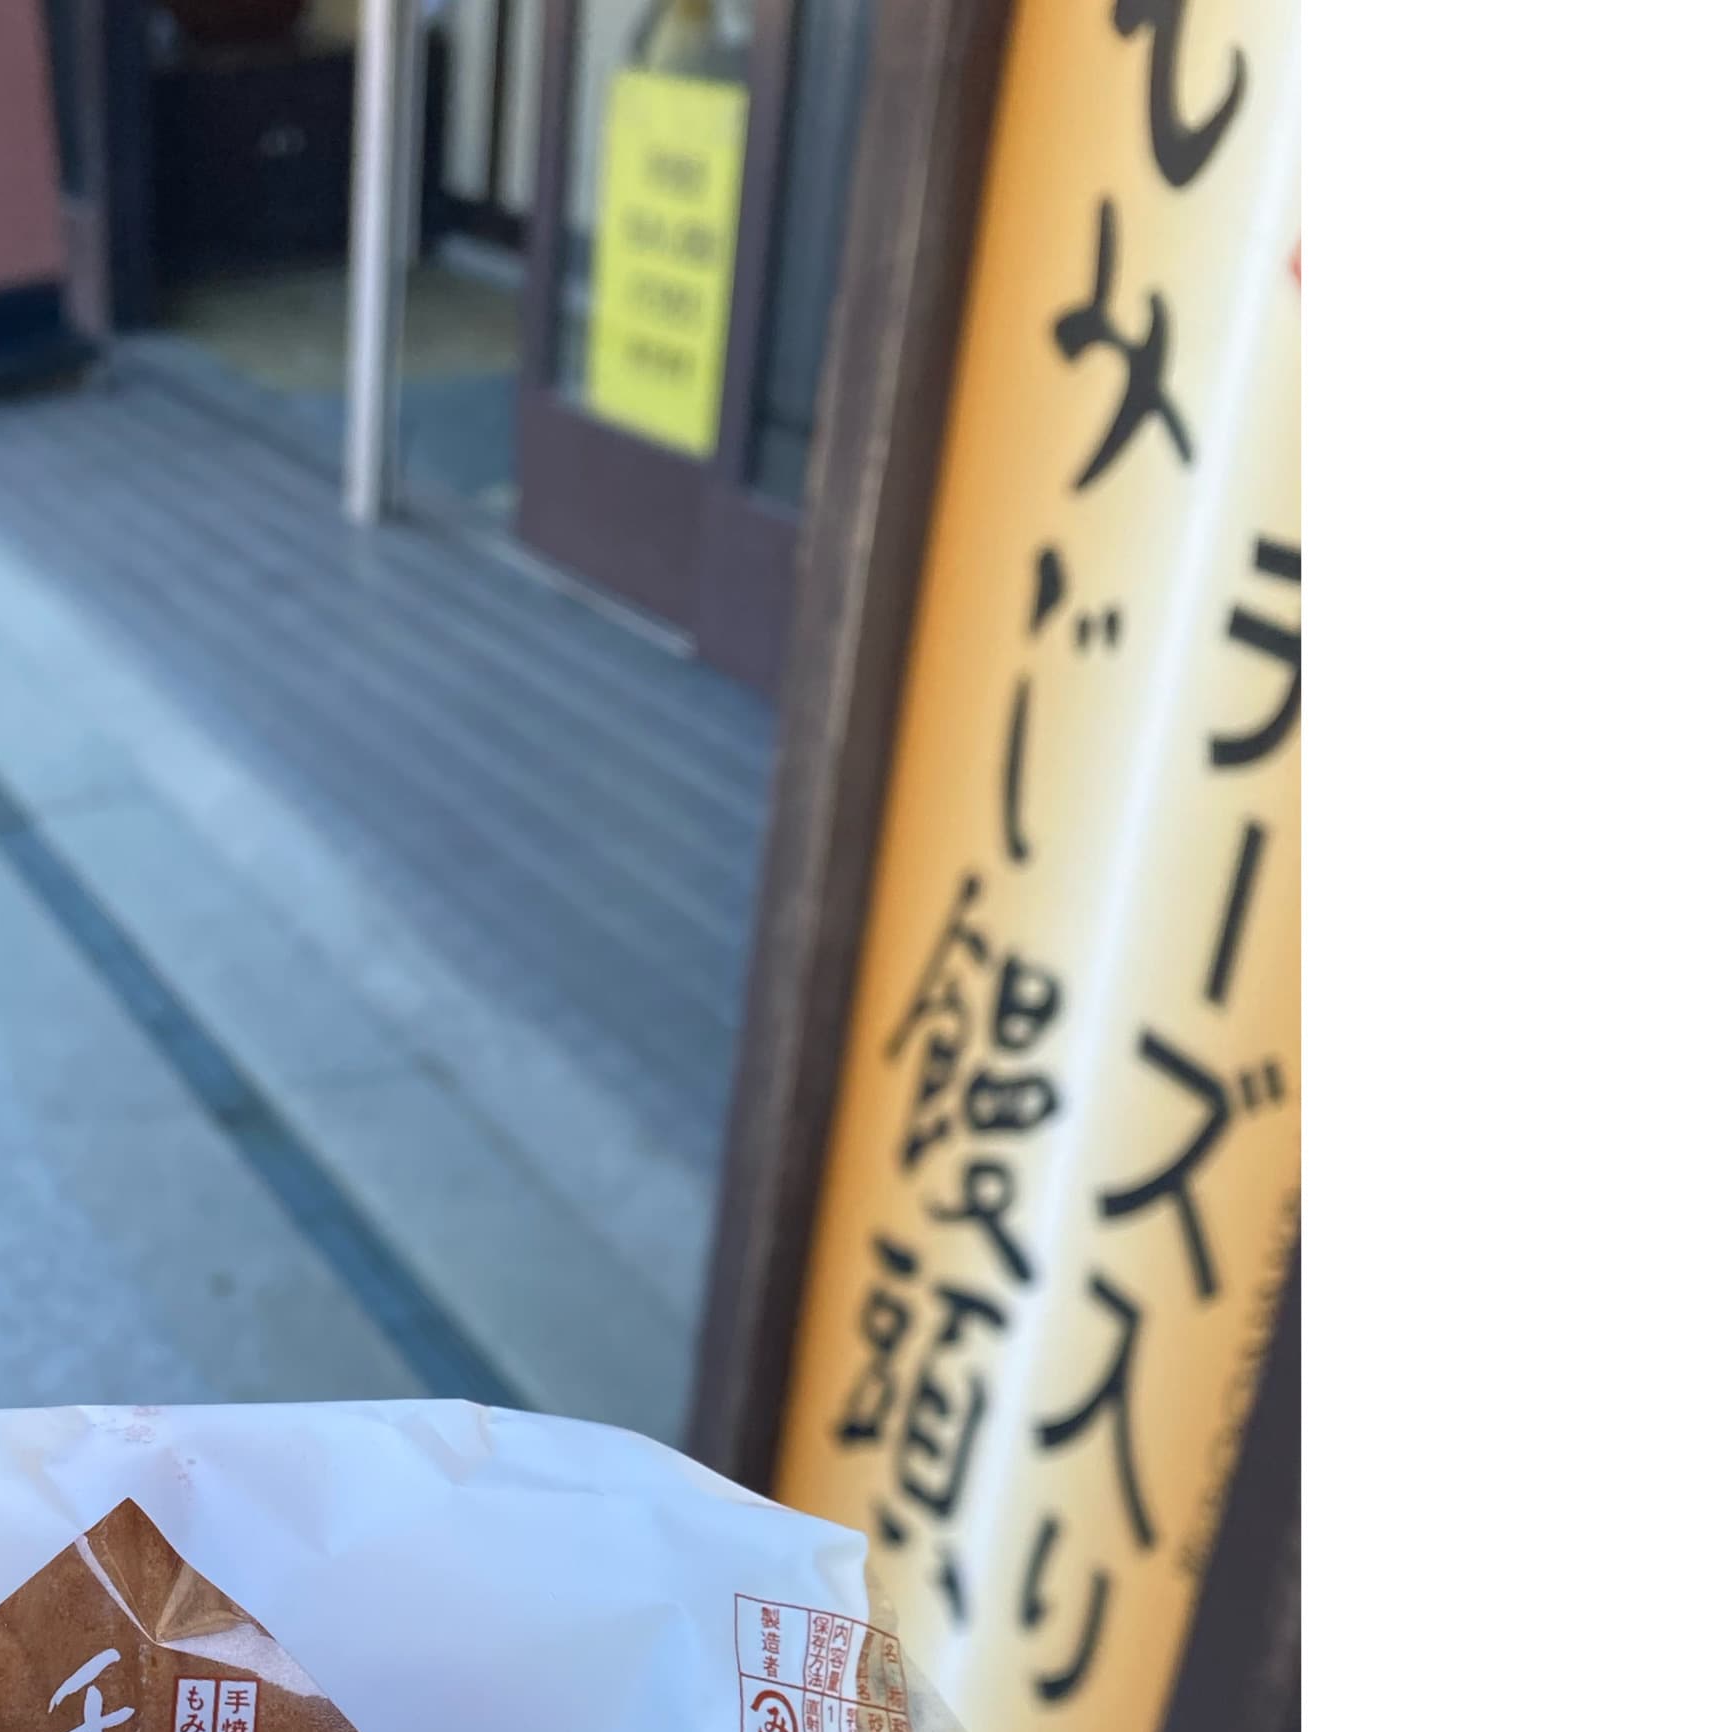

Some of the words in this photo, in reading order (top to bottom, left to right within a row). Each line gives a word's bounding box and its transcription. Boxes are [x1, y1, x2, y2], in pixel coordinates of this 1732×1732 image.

[760, 1606, 780, 1678] 製造者
[806, 1616, 831, 1689] 保存方法
[825, 1622, 850, 1694] 内容量
